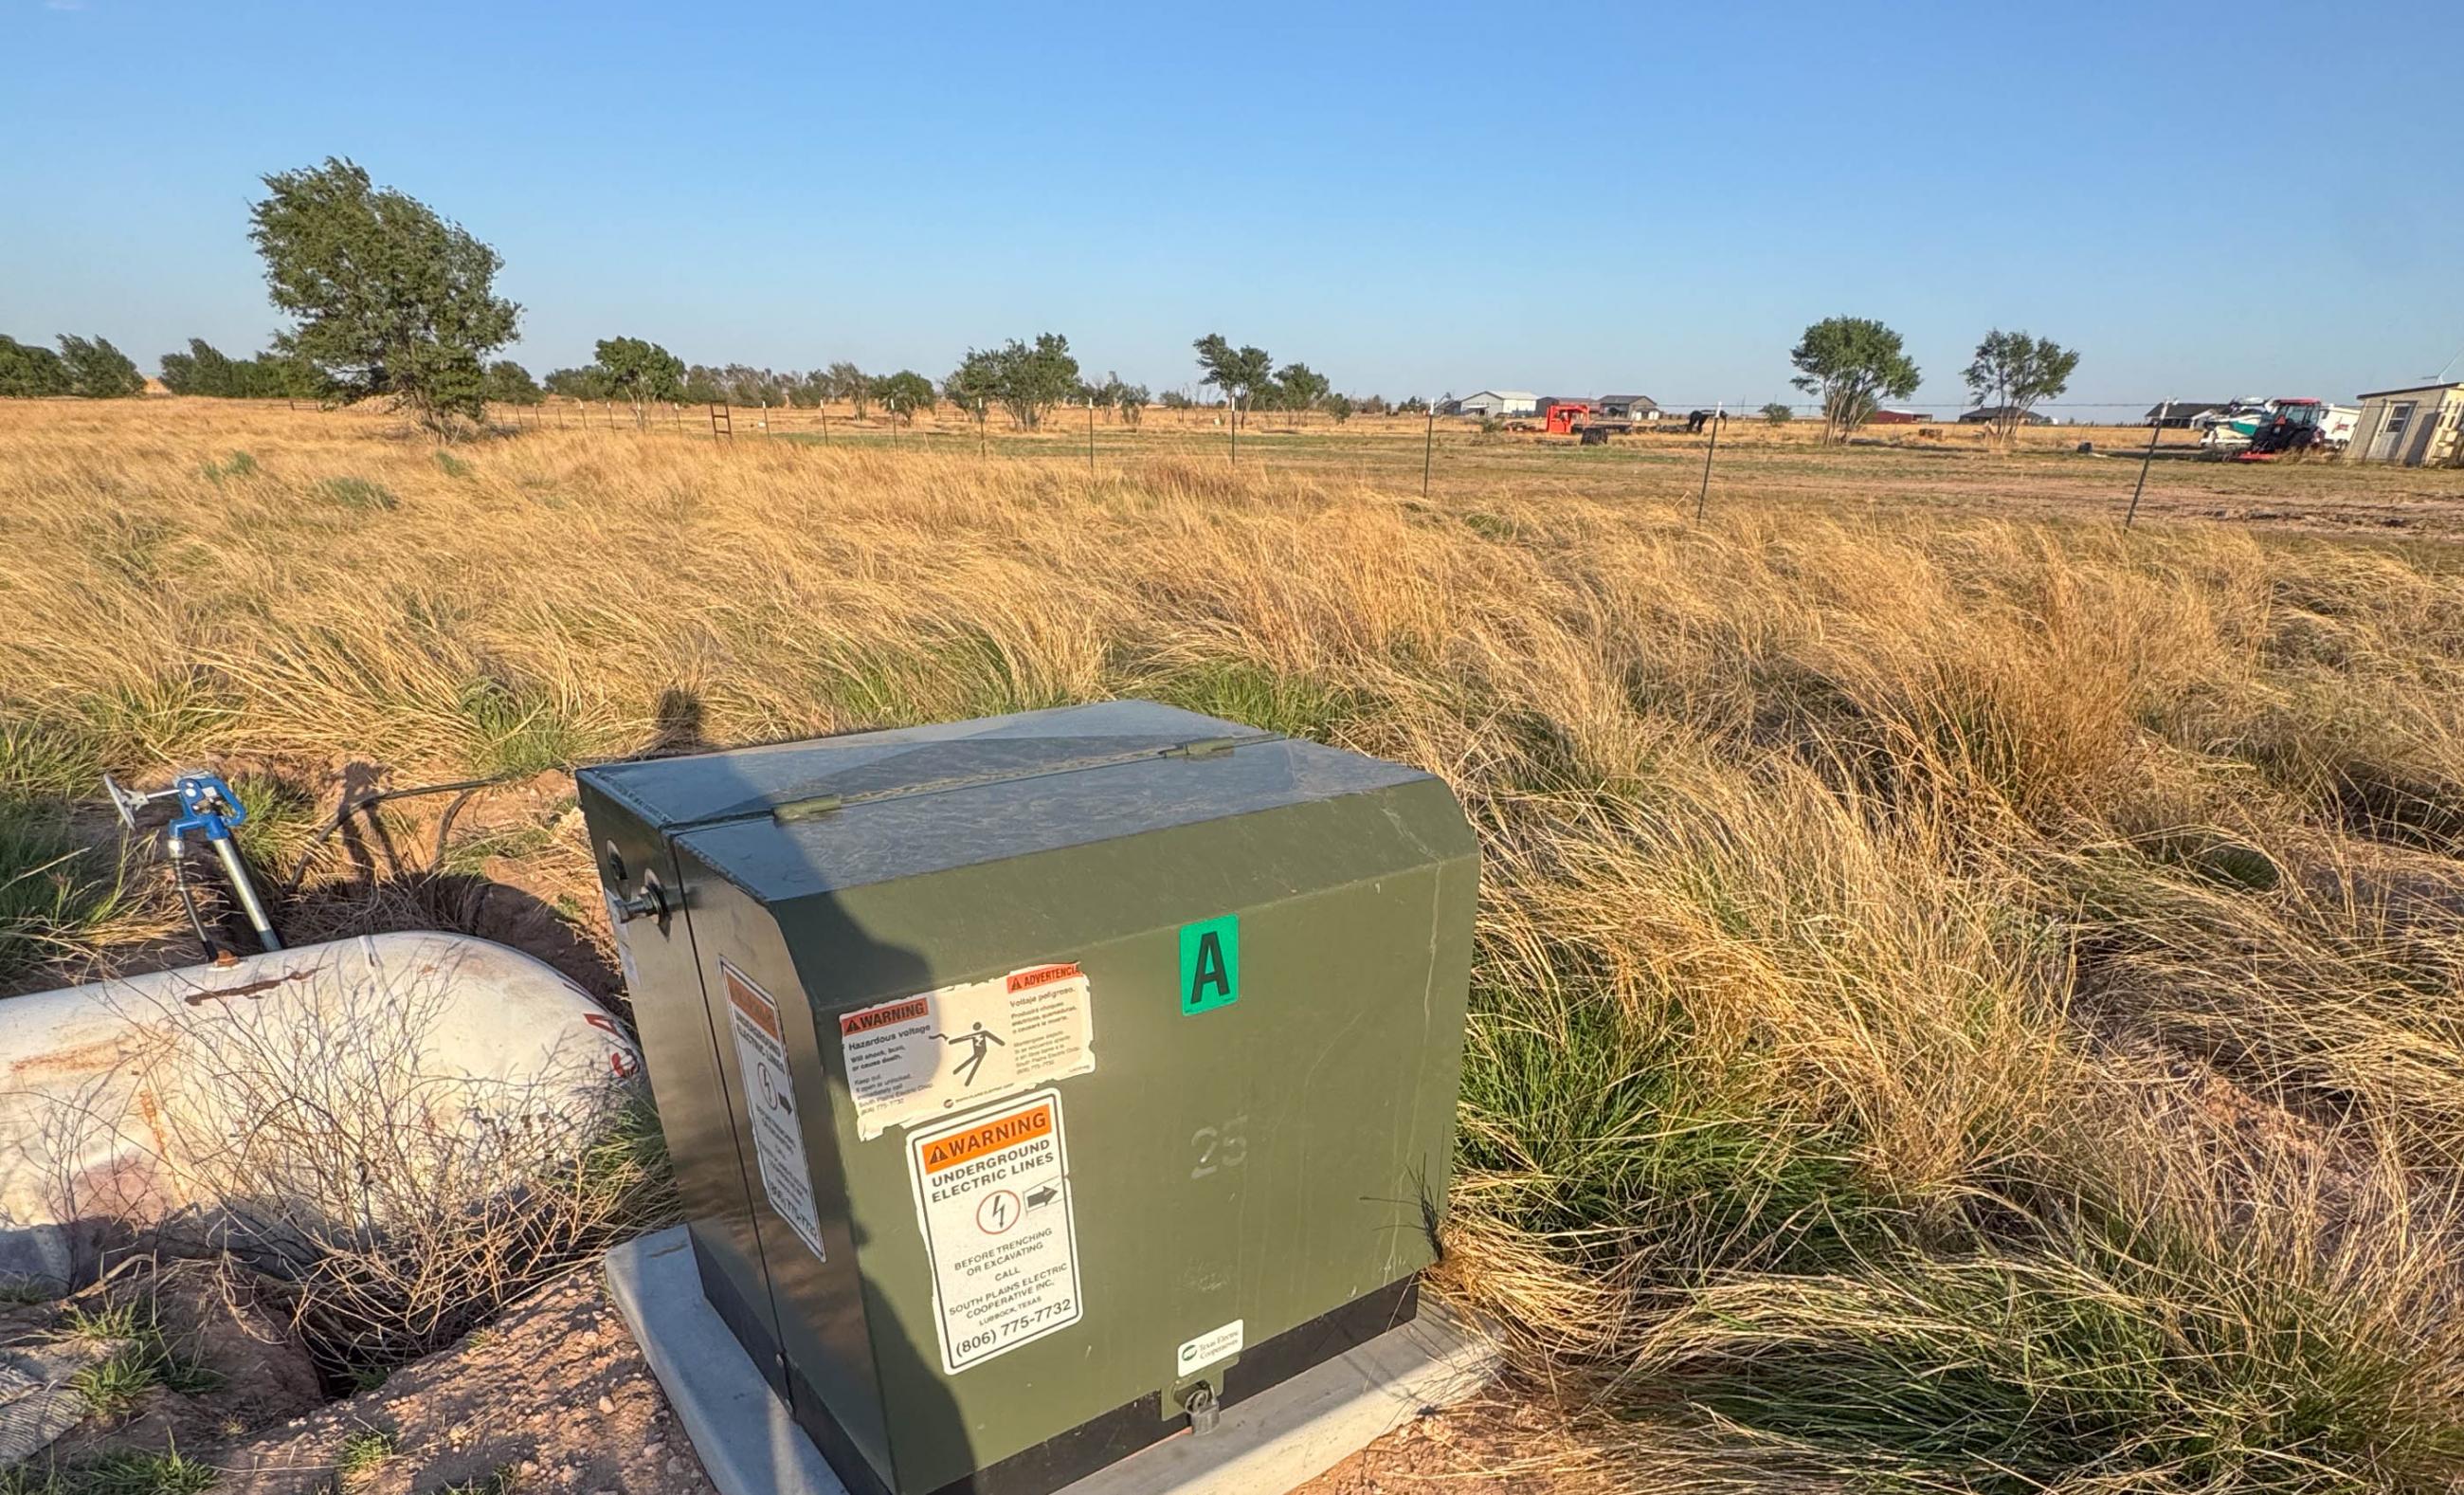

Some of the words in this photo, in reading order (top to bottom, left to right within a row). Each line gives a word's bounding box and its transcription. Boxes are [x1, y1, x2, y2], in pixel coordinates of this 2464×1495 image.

[1190, 930, 1230, 1005] A
[860, 1002, 925, 1029] WARNING
[848, 1033, 897, 1051] Hazardous
[898, 1025, 931, 1038] voltage
[948, 1112, 1046, 1158] WARNING
[932, 1139, 1050, 1188] UNDERGROUND
[932, 1169, 1006, 1204] ELECTRIC
[1011, 1152, 1055, 1176] LINES
[954, 1248, 995, 1271] BEFORE
[996, 1228, 1053, 1255] TRENCHING
[966, 1265, 982, 1277] OR
[984, 1243, 1043, 1271] EXCAVATING
[949, 1296, 984, 1317] SOUTH
[986, 1281, 1020, 1302] PLAINS
[1022, 1263, 1068, 1287] ELECTRIC
[995, 1267, 1021, 1282] CALL
[966, 1286, 1034, 1320] COOPERATIVE
[1018, 1296, 1042, 1312] TEXAS
[955, 1329, 996, 1358] (806)
[1000, 1298, 1072, 1337] 775-7732
